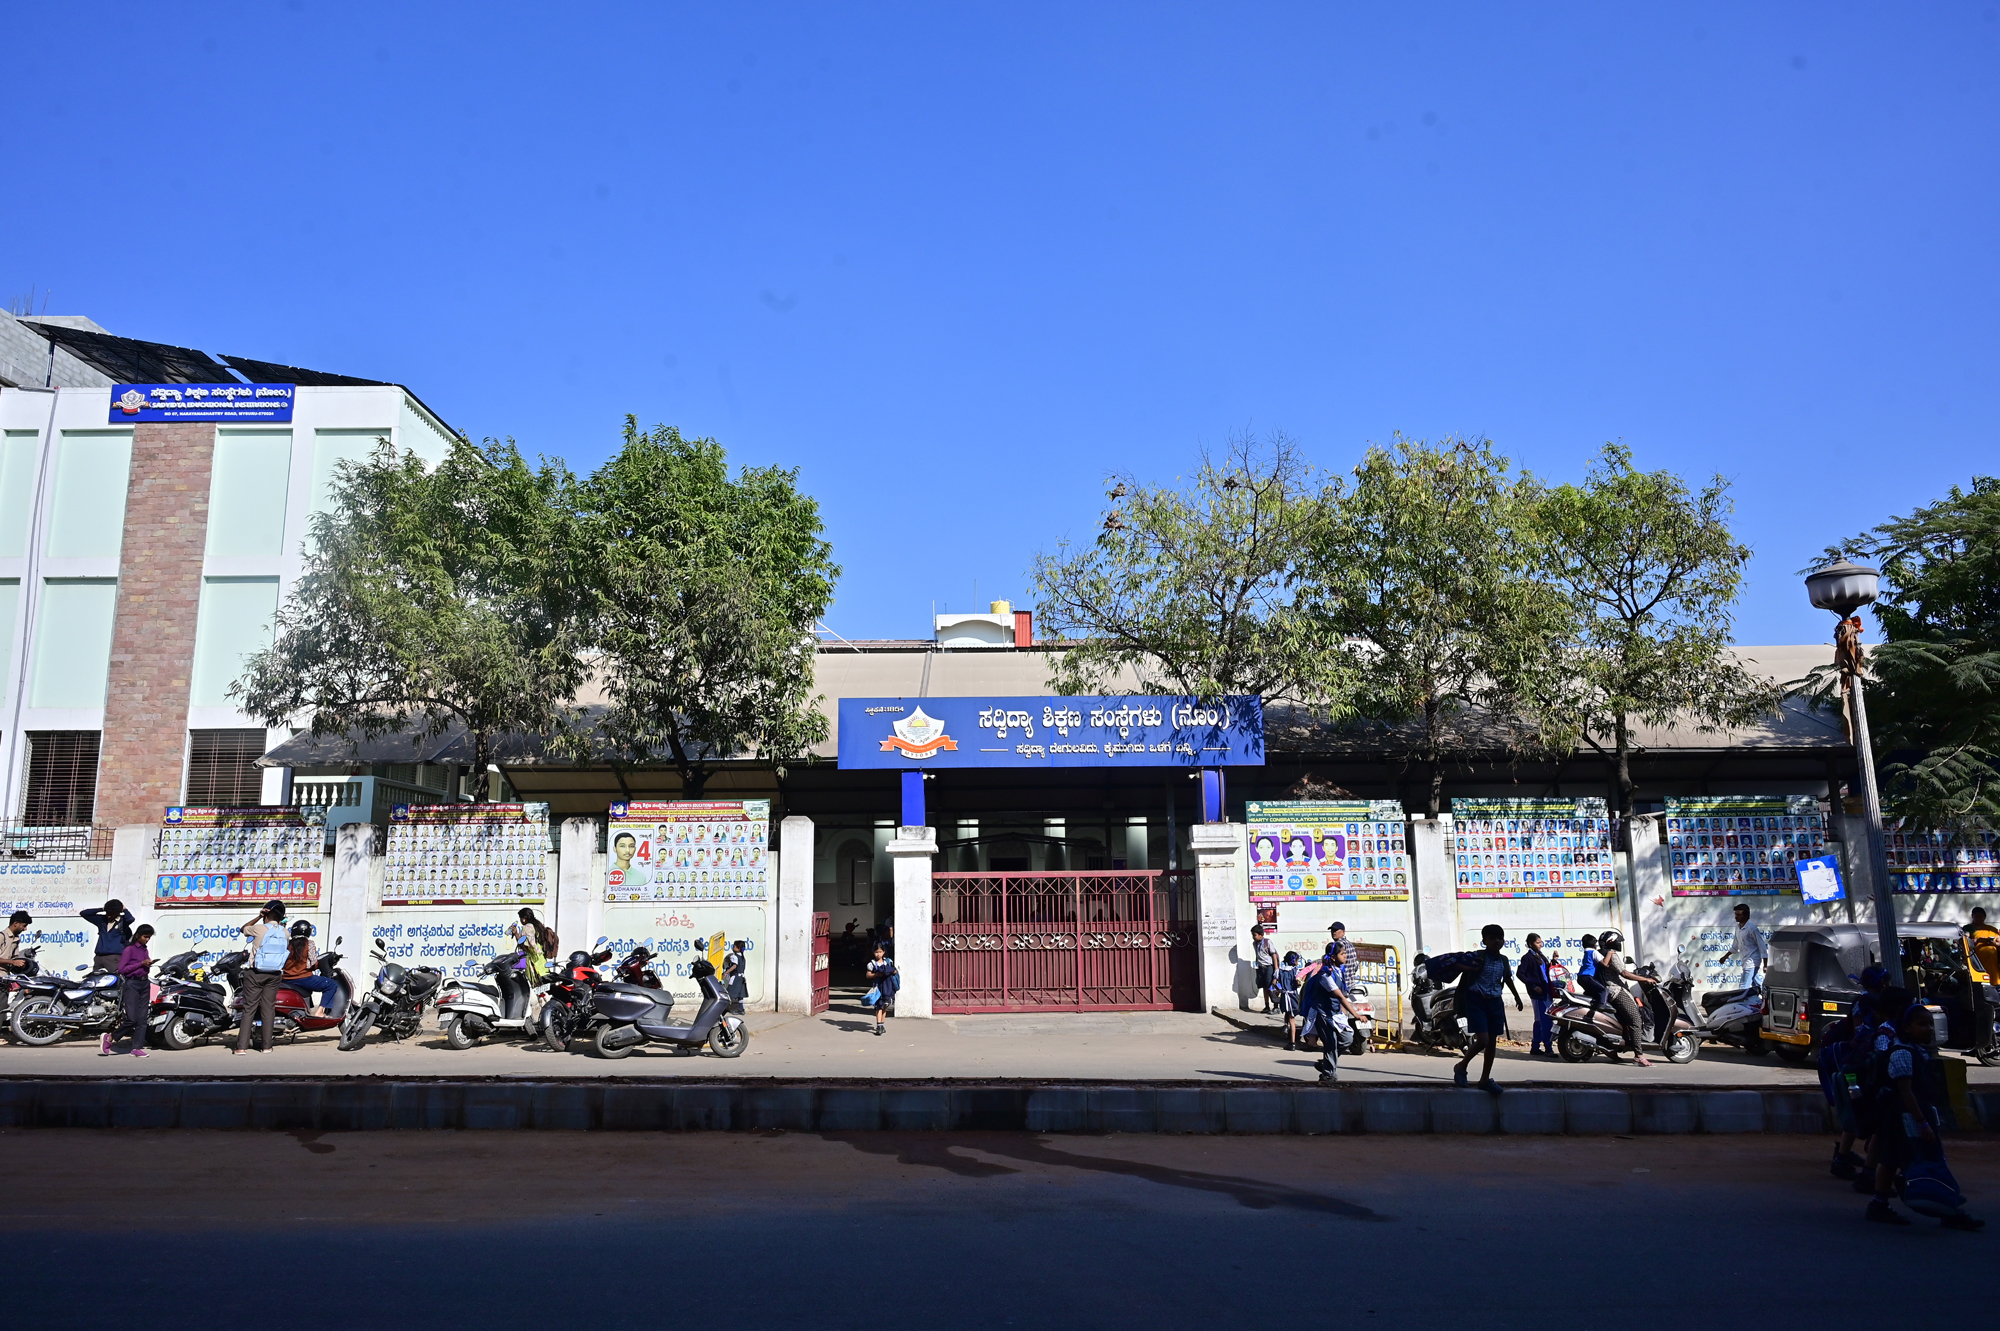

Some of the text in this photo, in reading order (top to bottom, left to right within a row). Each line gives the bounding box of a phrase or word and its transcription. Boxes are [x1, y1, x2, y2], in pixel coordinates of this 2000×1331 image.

[979, 705, 1034, 738] ಸದ್ವಿದ್ಯಾ
[1042, 705, 1082, 737] ಶಿಕ್ಷಣ
[1090, 704, 1162, 739] ಸಂಸ್ಥೆಗಳು
[1016, 743, 1045, 758] ಸದ್ವಿದ್ಯಾ
[1249, 828, 1258, 843] 7
[1281, 828, 1291, 842] 9
[1313, 828, 1323, 842] 9
[637, 841, 650, 861] 4
[372, 924, 402, 941] ಪರೀಕ್ಷೆಗೆ
[407, 924, 454, 942] ಅಗತ್ಯವಿರುವ
[458, 923, 503, 938] ಪ್ರವೇಶಪತ್ರ
[387, 942, 496, 960] ಇತರೆ ಸಲಕರಣೆಗಳನ್ನು
[658, 938, 689, 956] ಸರಸ್ವತಿ
